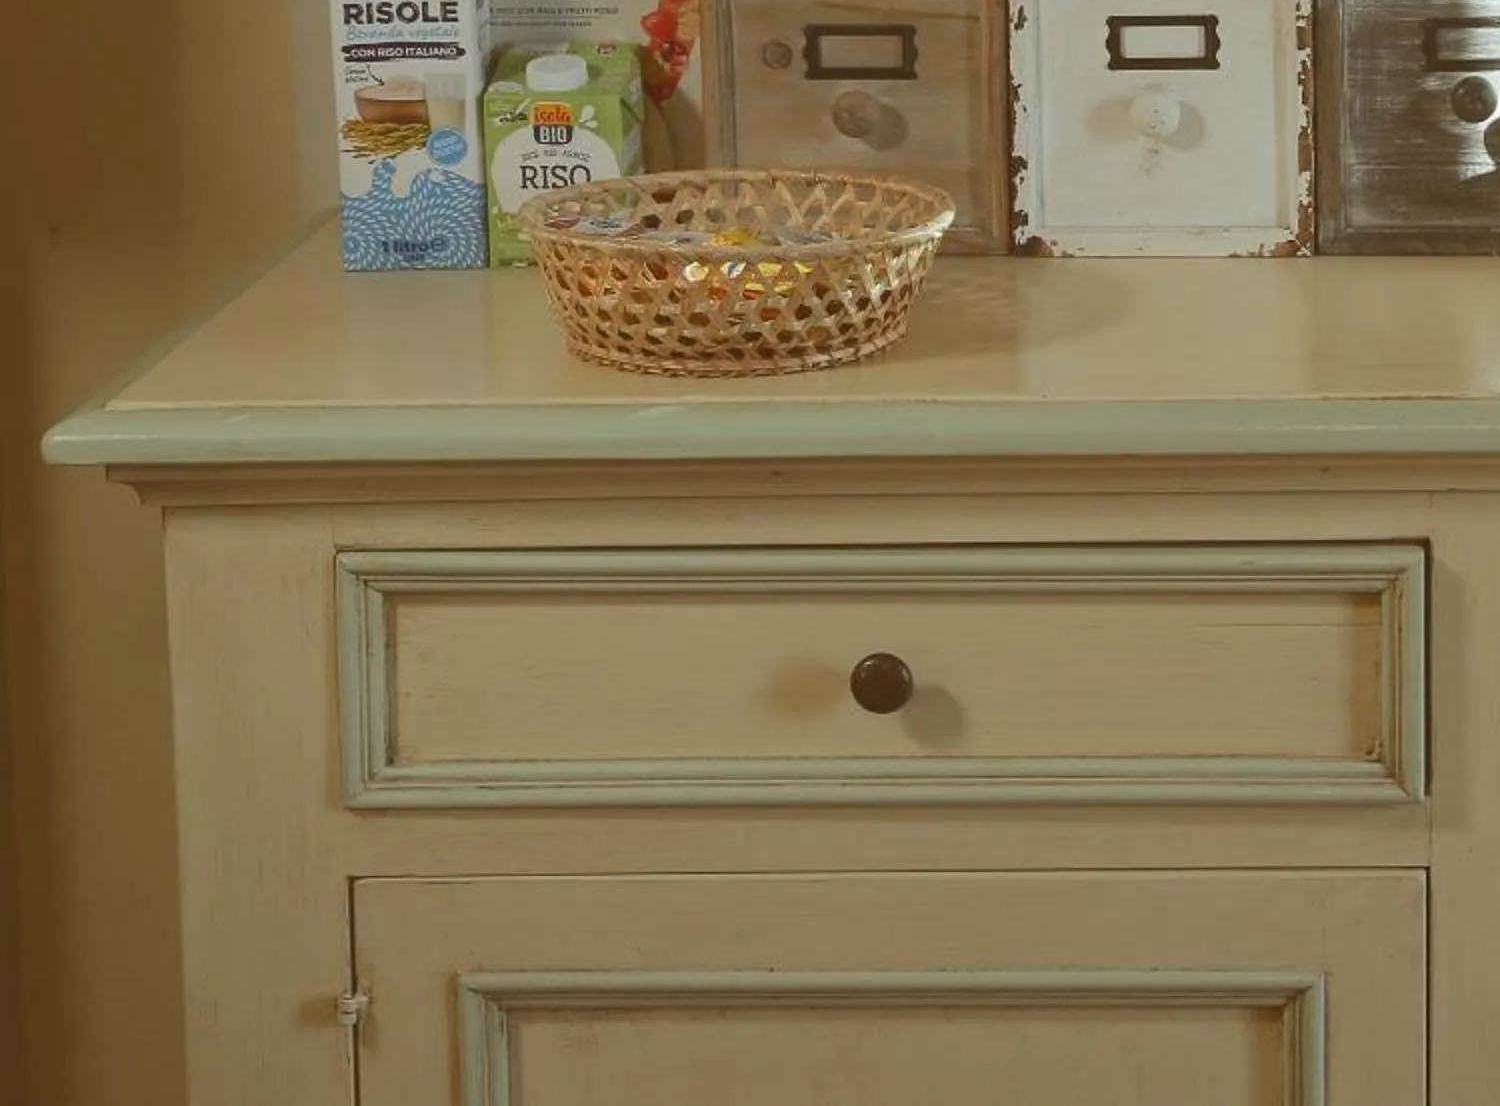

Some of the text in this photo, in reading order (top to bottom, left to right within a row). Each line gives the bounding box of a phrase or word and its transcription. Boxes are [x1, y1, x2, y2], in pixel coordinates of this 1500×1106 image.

[350, 46, 457, 59] CON RISO ITALIANO
[540, 126, 567, 143] BIO
[520, 164, 591, 189] RISO
